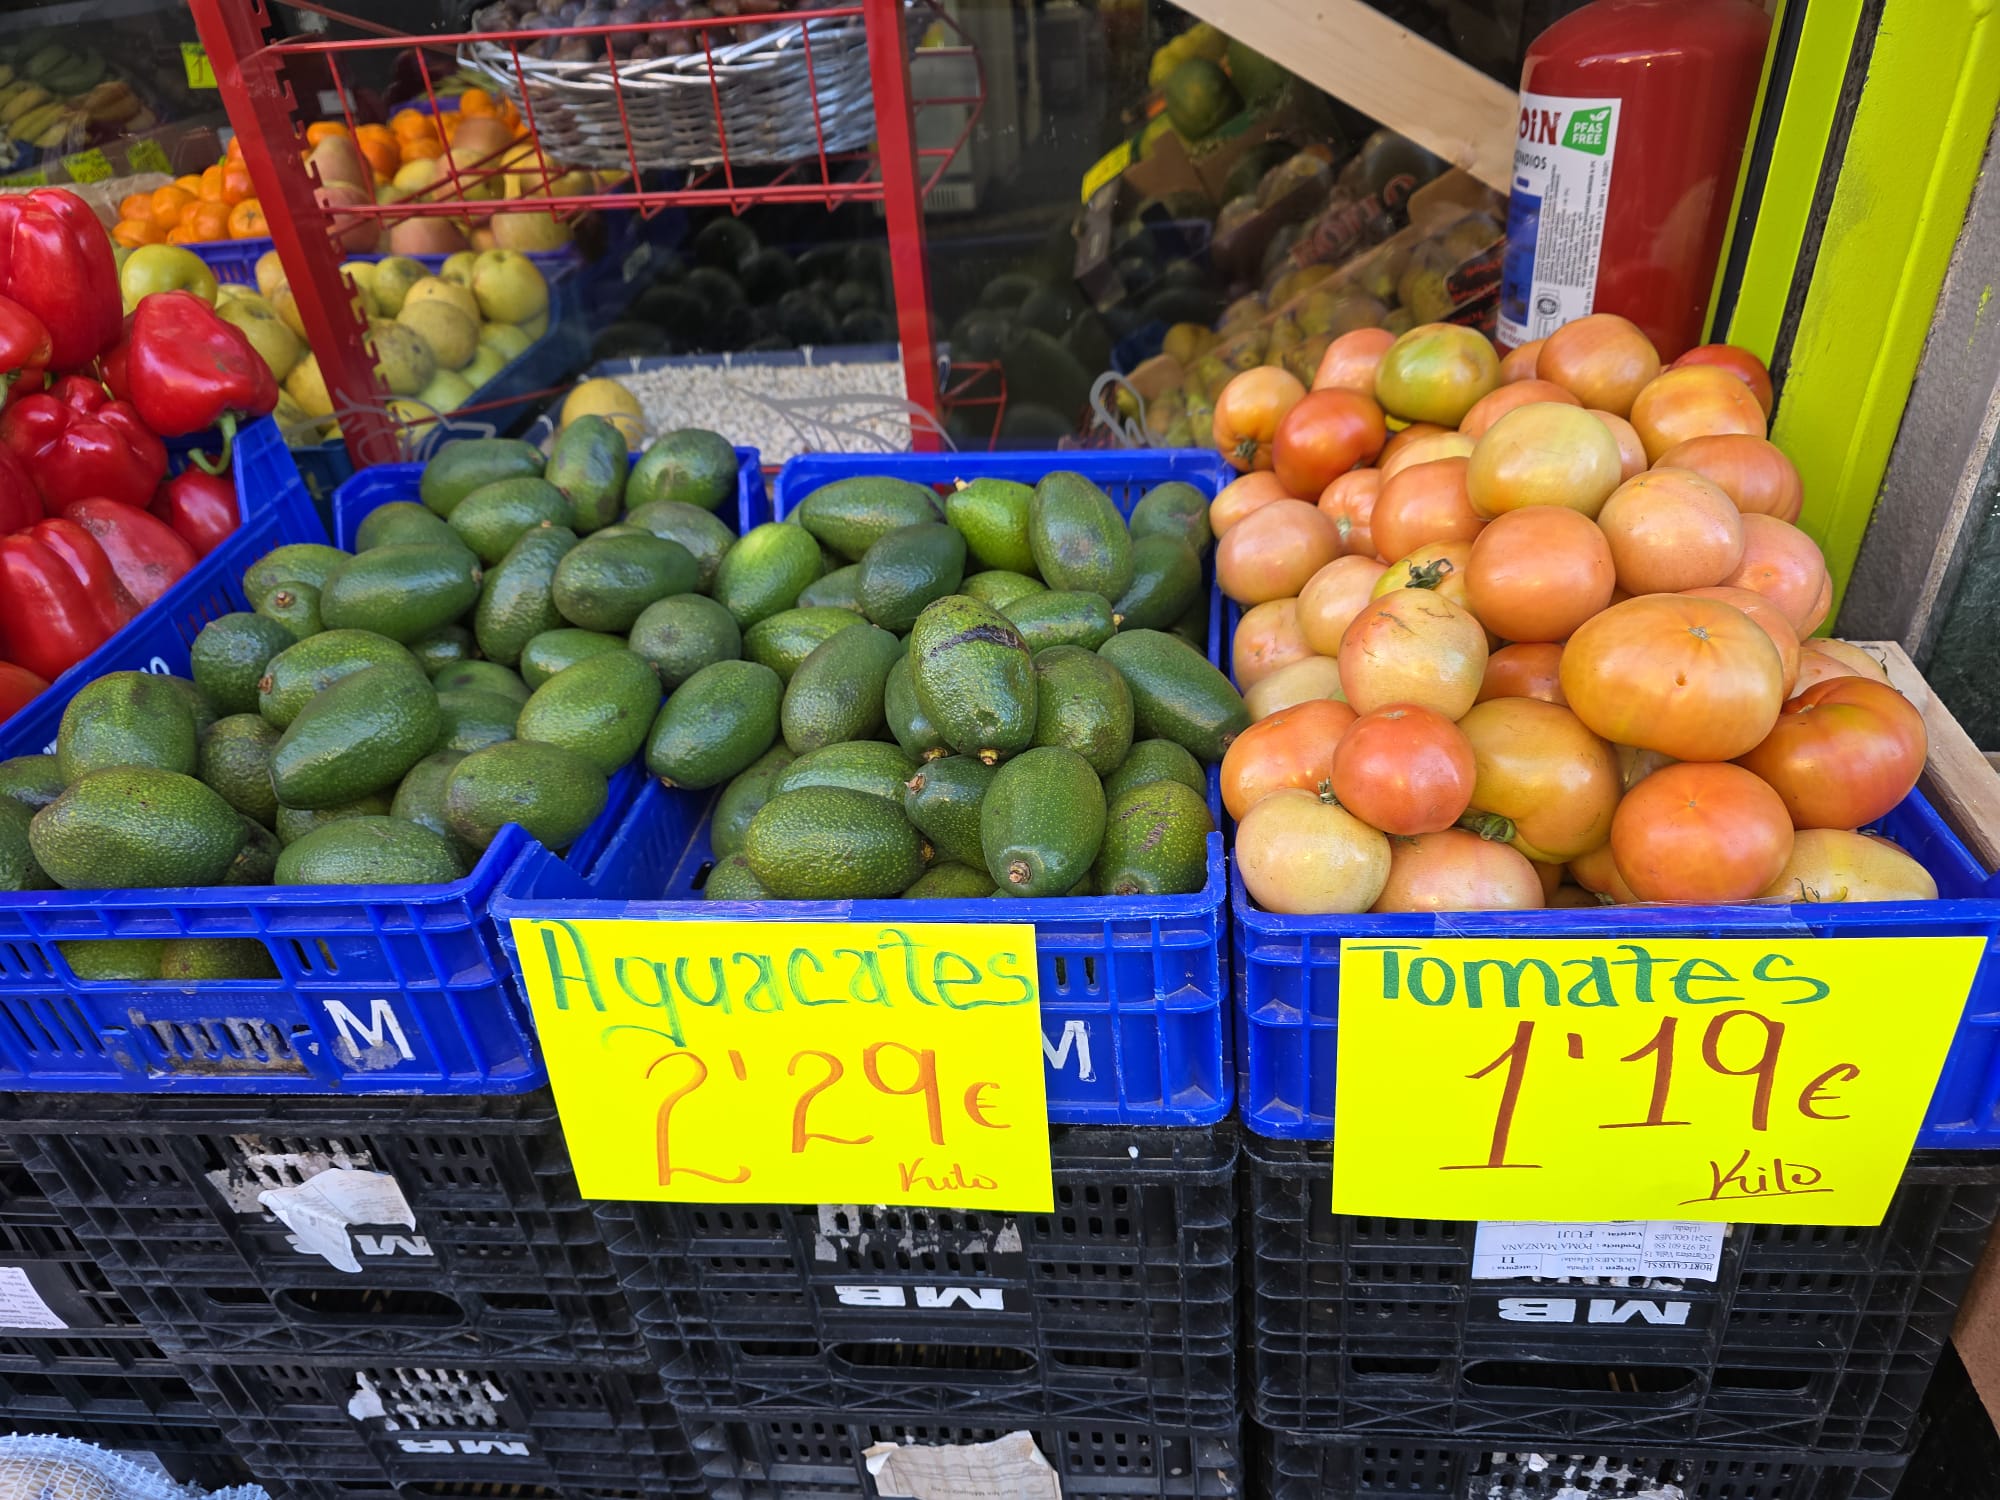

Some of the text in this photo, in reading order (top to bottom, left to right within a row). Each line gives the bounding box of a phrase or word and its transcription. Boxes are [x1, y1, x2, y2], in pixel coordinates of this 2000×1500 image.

[1571, 133, 1602, 145] FREE
[1573, 122, 1603, 133] PFAS
[530, 920, 1035, 1049] Aguacates
[1346, 944, 1832, 1008] Tomates
[323, 999, 416, 1060] M
[1708, 1148, 1824, 1202] Kilo
[1501, 1242, 1558, 1251] MANZANA
[1557, 1230, 1594, 1239] FUJI
[1689, 1263, 1713, 1272] HORT
[834, 1285, 1004, 1310] MB
[1498, 1297, 1691, 1325] MB
